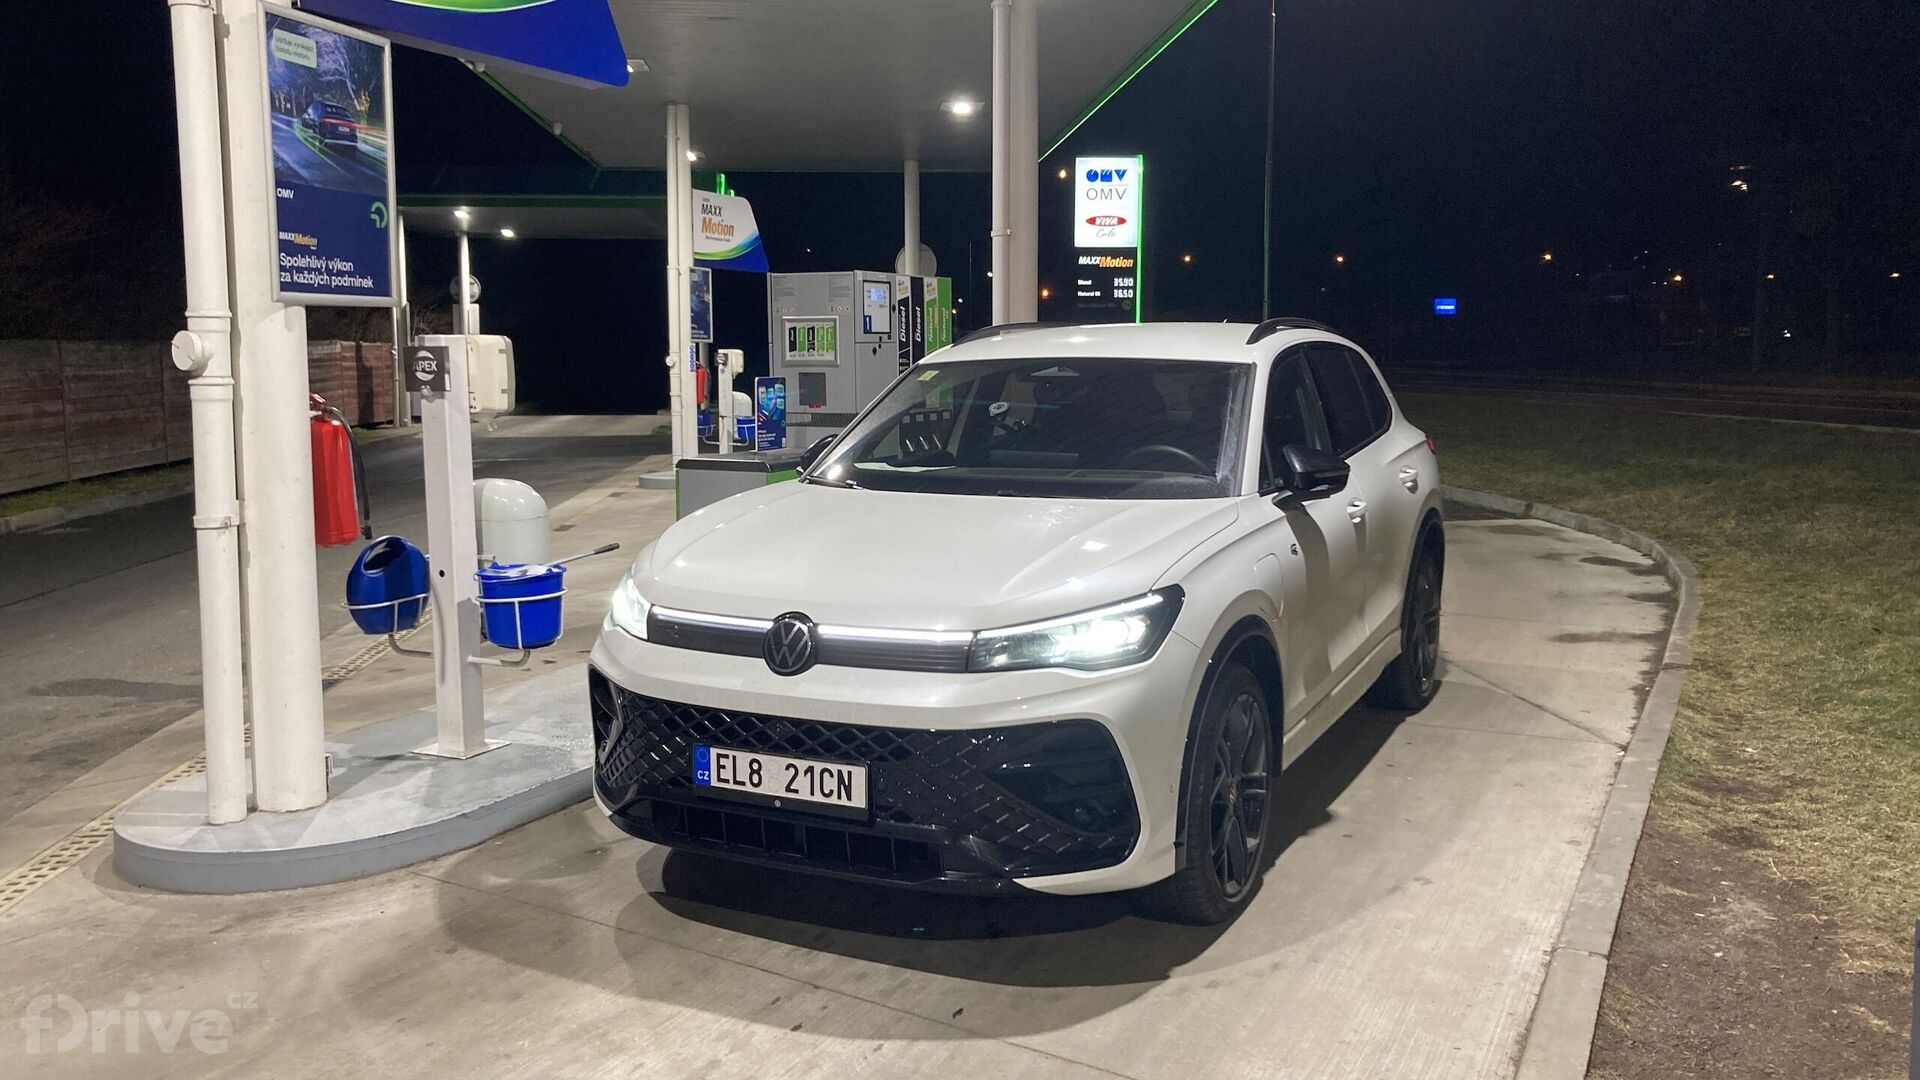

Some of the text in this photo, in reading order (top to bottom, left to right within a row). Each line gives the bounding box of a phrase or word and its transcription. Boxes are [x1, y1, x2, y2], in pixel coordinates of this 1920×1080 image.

[276, 188, 294, 199] OMV
[1086, 188, 1128, 200] OMV
[701, 203, 723, 217] MAXX
[701, 217, 735, 237] Motion
[1095, 216, 1119, 226] VIVA
[280, 253, 354, 273] Spolehlivý výkon
[280, 270, 374, 289] za každých podmínek
[697, 770, 710, 781] CZ
[716, 752, 852, 802] EL8 21CN
